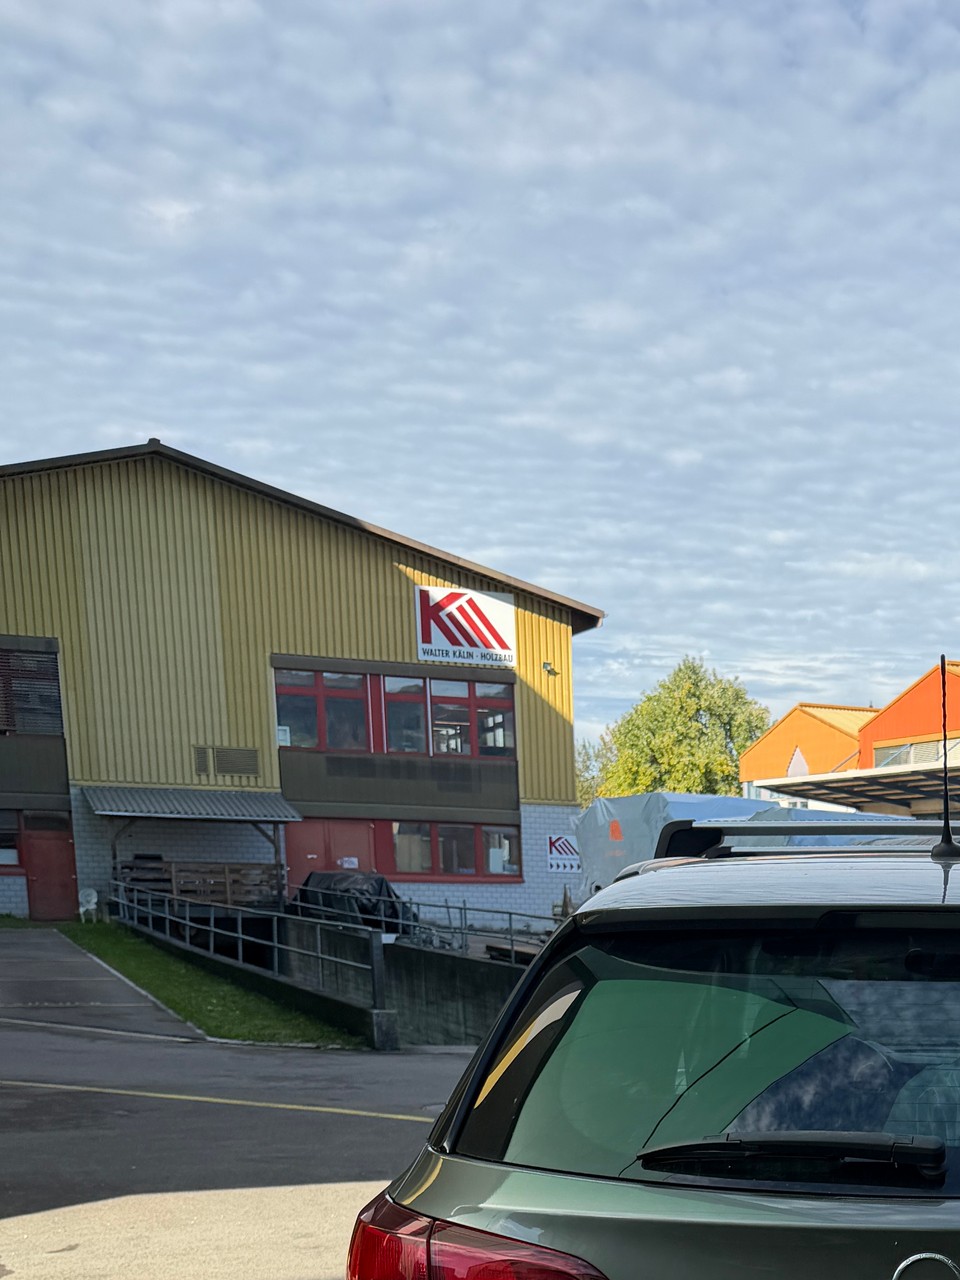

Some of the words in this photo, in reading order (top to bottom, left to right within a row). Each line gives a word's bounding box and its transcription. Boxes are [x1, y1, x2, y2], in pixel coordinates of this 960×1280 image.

[422, 647, 450, 658] WALTER
[453, 649, 474, 660] KÄLIN
[480, 653, 513, 663] HOLZBAU
